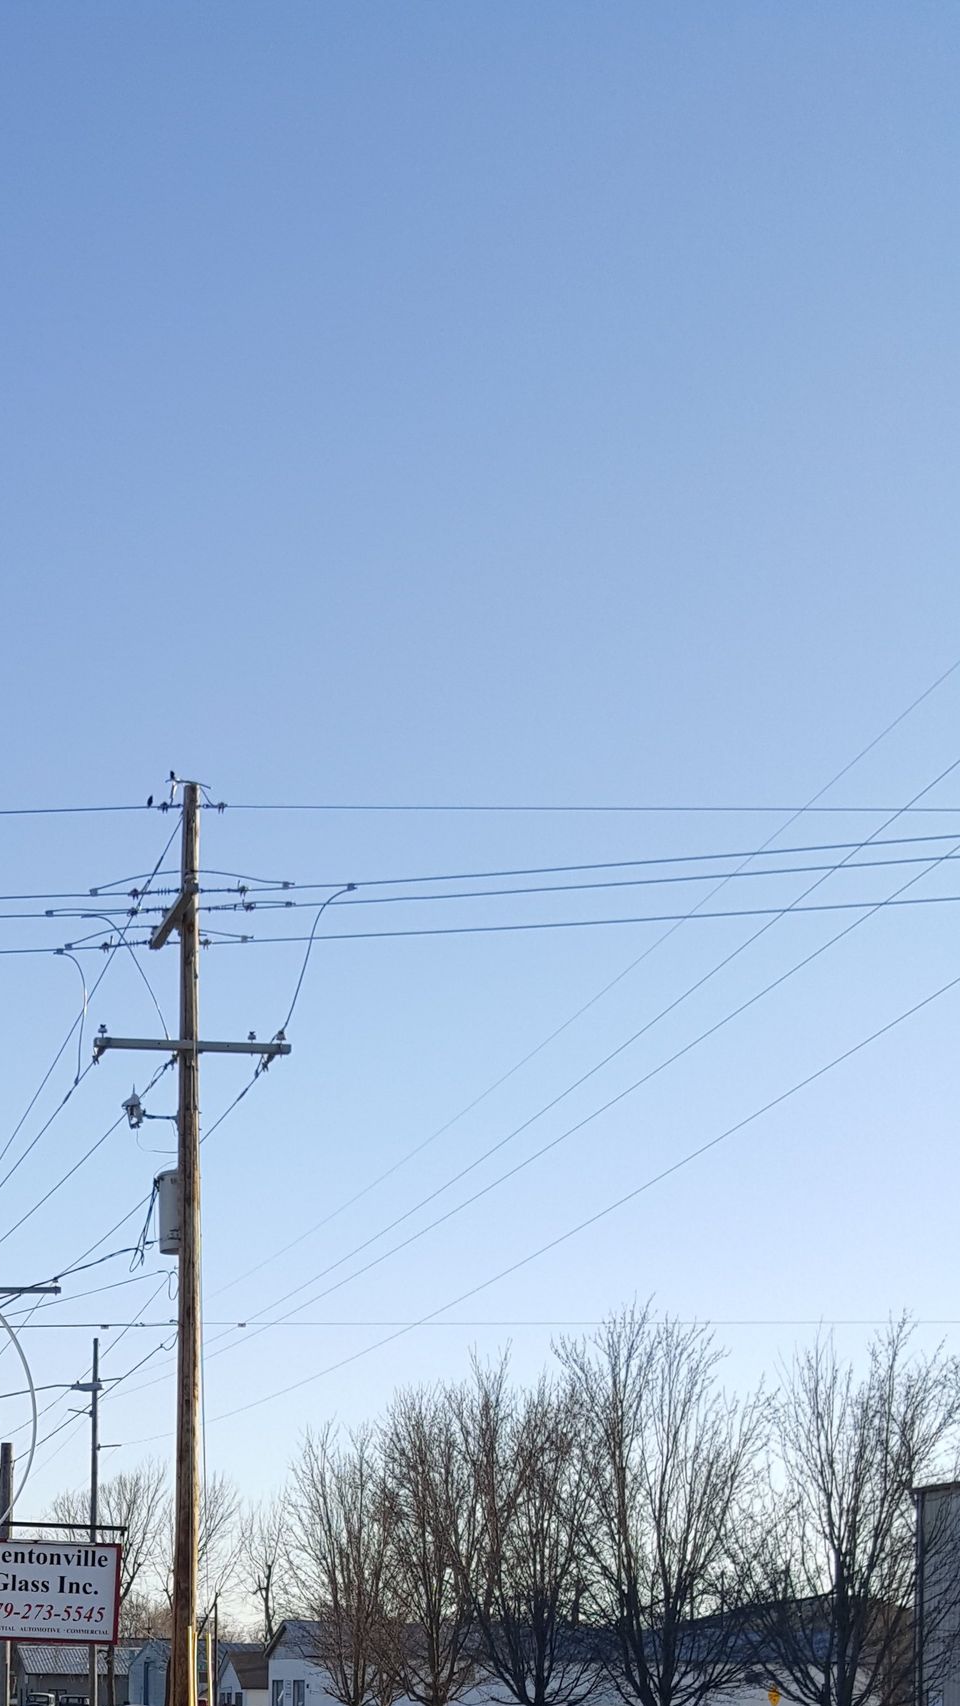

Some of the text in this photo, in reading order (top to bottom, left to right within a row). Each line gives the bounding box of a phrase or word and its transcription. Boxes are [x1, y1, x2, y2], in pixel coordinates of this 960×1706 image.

[57, 1575, 98, 1595] Inc.
[20, 1626, 61, 1634] AUTOMOTIVE
[66, 1628, 110, 1636] COMMERCIAL
